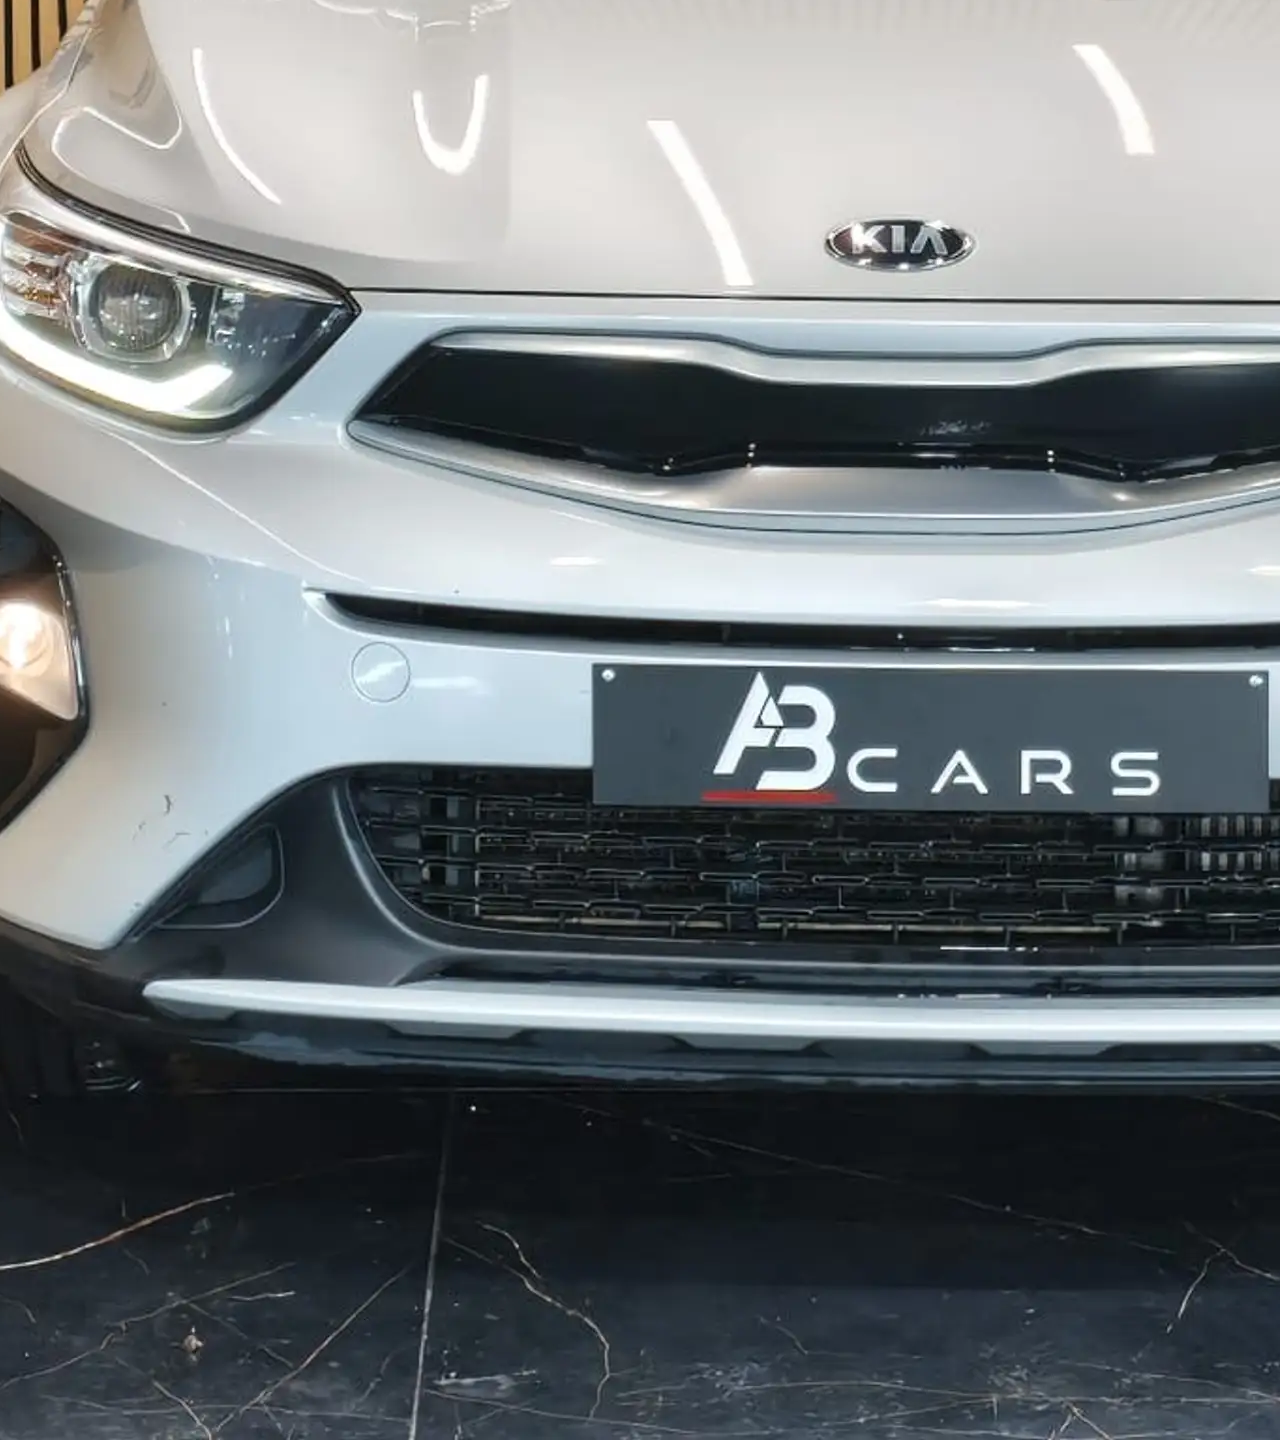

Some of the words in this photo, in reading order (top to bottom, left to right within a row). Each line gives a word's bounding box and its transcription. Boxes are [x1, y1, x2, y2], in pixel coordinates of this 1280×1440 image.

[851, 224, 948, 255] KIA
[713, 671, 836, 791] AB
[846, 747, 1162, 797] CARS
